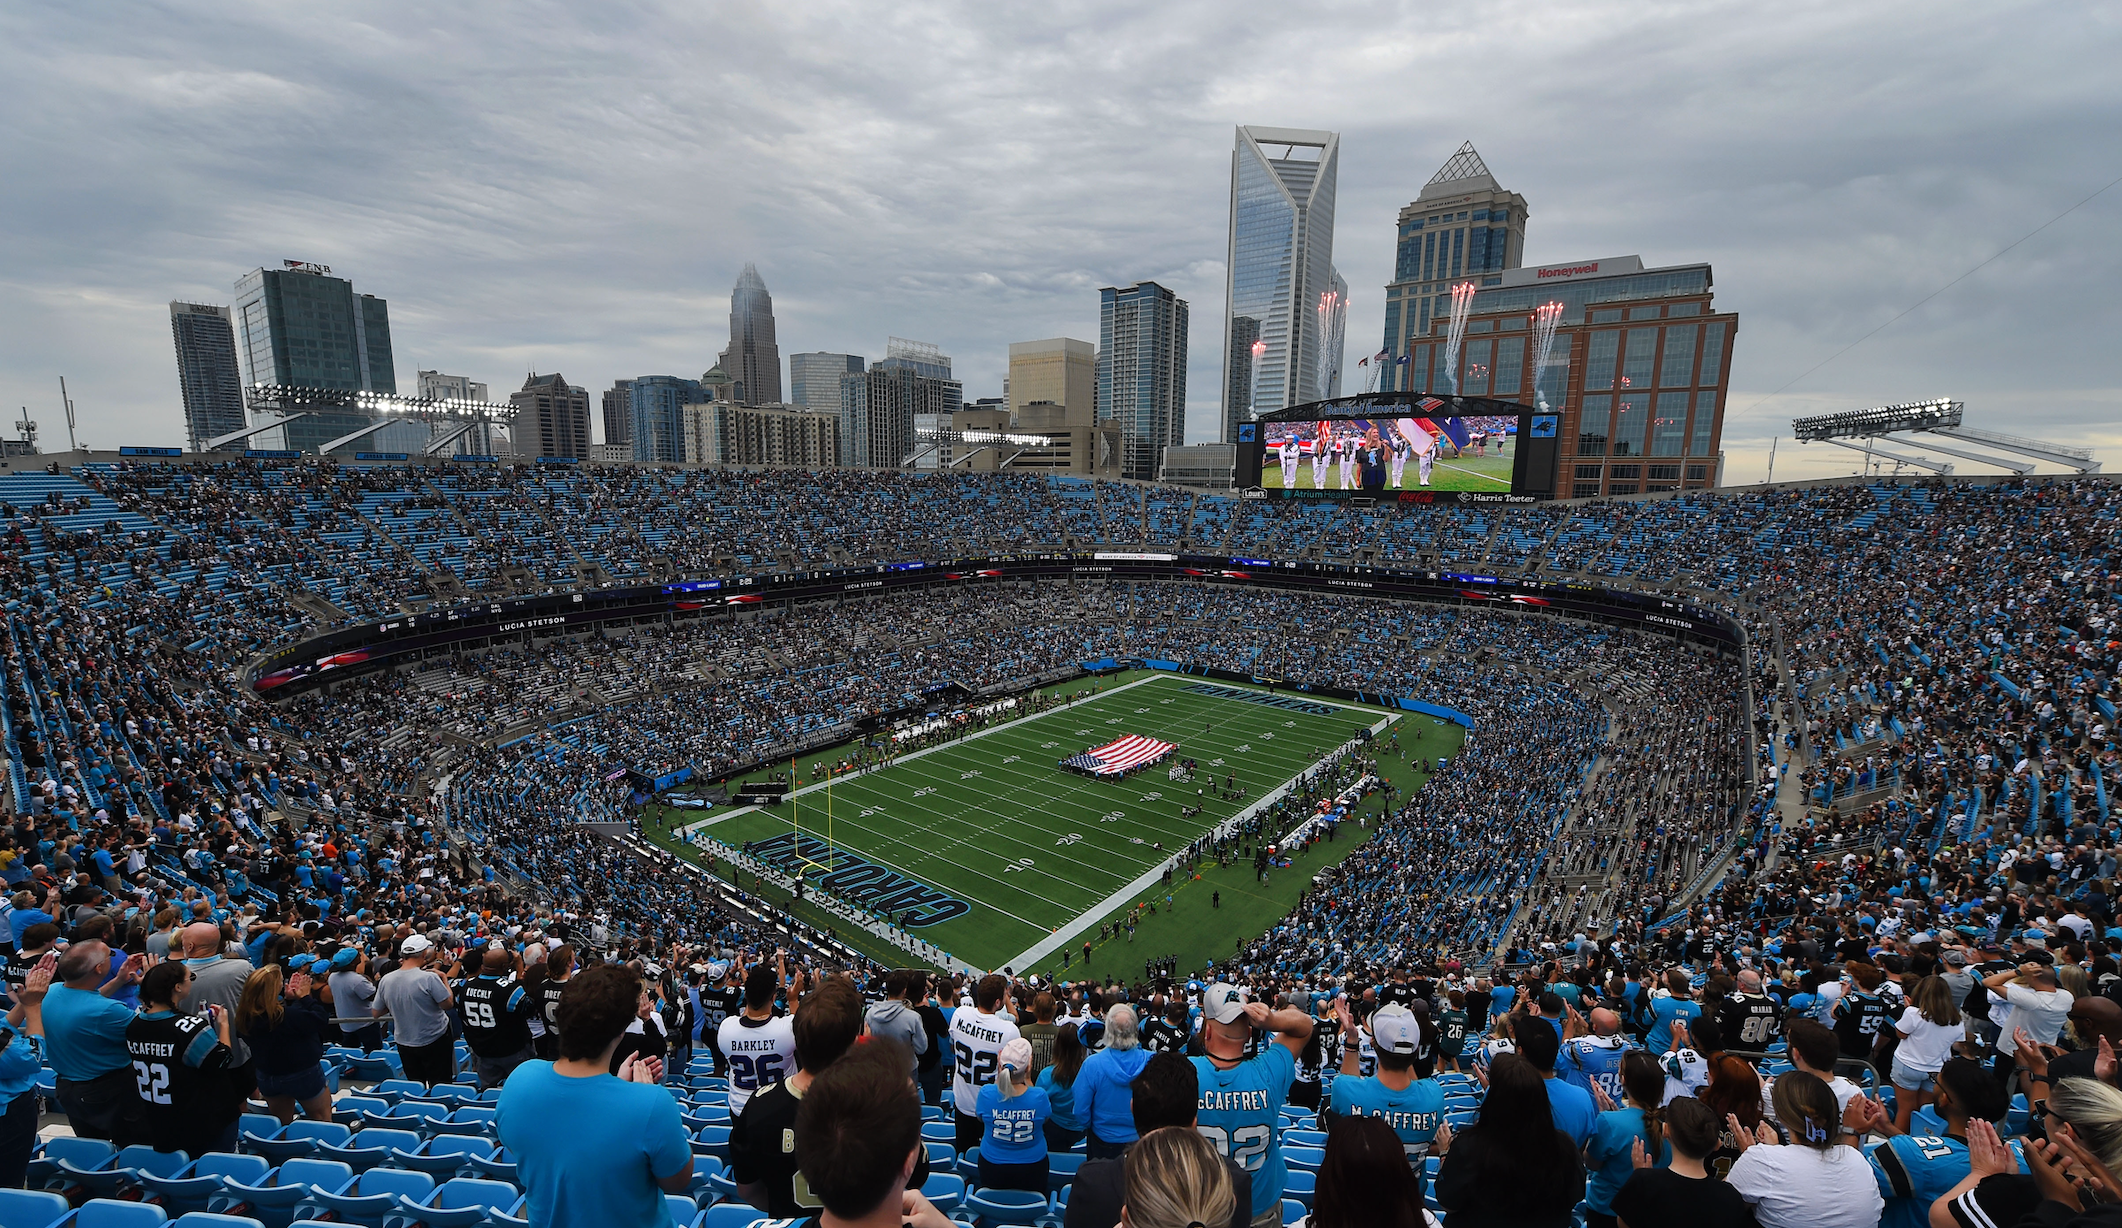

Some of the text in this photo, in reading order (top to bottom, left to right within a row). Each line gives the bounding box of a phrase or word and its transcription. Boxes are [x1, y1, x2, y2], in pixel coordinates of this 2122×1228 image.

[305, 262, 332, 273] FNB
[1537, 262, 1599, 279] Honeywell
[1324, 402, 1412, 416] Bank of America
[1294, 490, 1352, 500] Atrium Health
[1473, 493, 1536, 503] Harris Teeter
[844, 581, 882, 590] LUCIA STETSON
[500, 616, 565, 632] LUCIA STETSON
[1645, 614, 1692, 629] LUCIA STETSON
[1100, 810, 1126, 824] 30
[1055, 832, 1084, 846] 20
[1003, 857, 1035, 874] 10
[752, 830, 972, 928] CAROLINA
[466, 986, 493, 1000] KUECHLY
[544, 989, 562, 1000] BRE
[464, 1001, 497, 1028] 59
[702, 1008, 727, 1031] 59
[956, 1018, 1004, 1044] McCAFFREY
[1448, 1024, 1464, 1039] 26
[1740, 1016, 1776, 1044] 80
[1858, 1015, 1884, 1035] 59
[730, 1038, 776, 1052] BARKLEY
[1578, 1041, 1594, 1054] 88
[954, 1040, 998, 1086] 22
[1606, 1060, 1621, 1068] OLSE
[1682, 1051, 1697, 1064] 99
[728, 1053, 784, 1090] 26
[132, 1060, 172, 1105] 22
[1197, 1089, 1268, 1111] cCAFFREY
[992, 1108, 1036, 1121] McCAFFREY
[1350, 1104, 1438, 1131] MCAFFREY
[992, 1120, 1034, 1143] 22
[1911, 1135, 1953, 1161] 21
